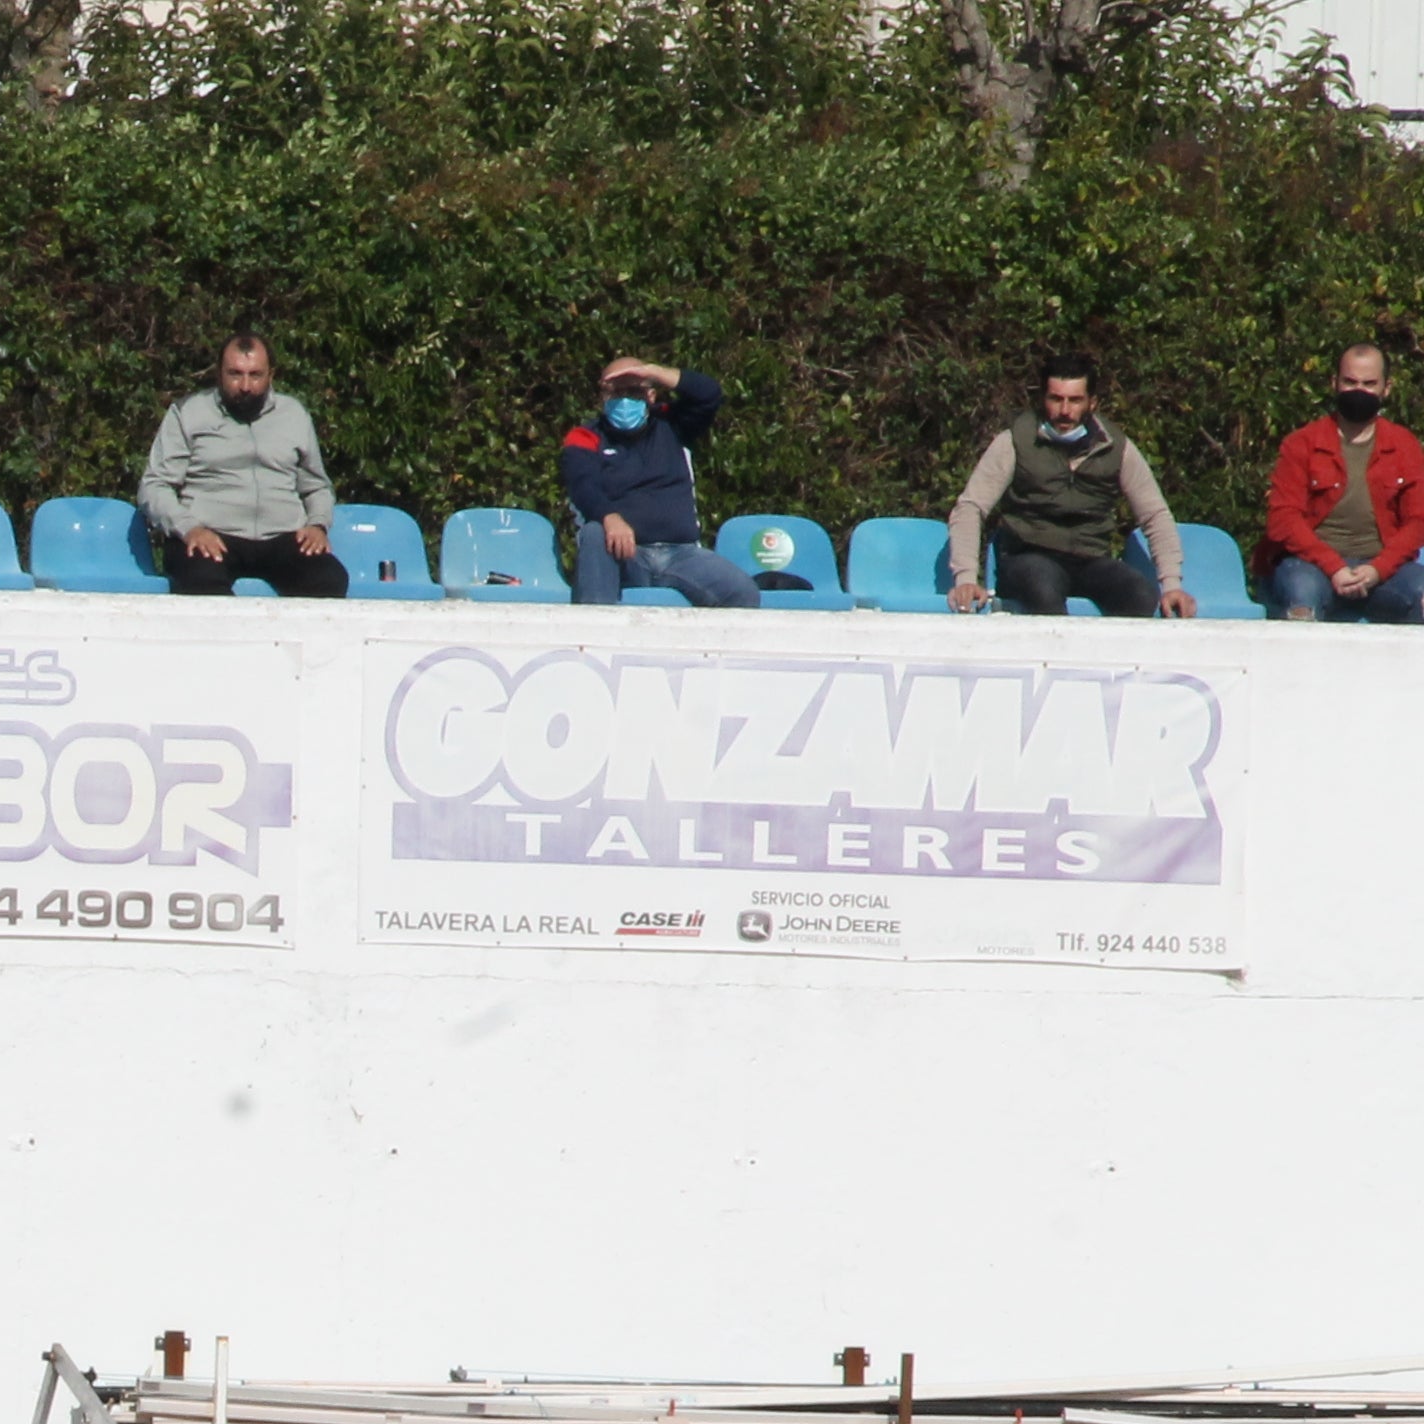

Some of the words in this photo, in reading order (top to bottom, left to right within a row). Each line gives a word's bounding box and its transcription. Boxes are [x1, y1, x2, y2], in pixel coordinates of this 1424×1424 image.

[390, 650, 1219, 820] GONZAMAR
[505, 811, 1104, 874] TALLERES
[36, 889, 153, 929] 490
[168, 892, 284, 933] 904
[751, 890, 824, 907] SERVICIO
[829, 893, 891, 909] OFICIAL
[375, 911, 496, 932] TALAVERA
[503, 915, 532, 934] LA
[539, 915, 600, 935] REAL
[620, 911, 683, 926] CASE
[779, 914, 832, 931] JOHN
[836, 916, 901, 934] DEERE
[779, 933, 827, 943] MOTORES
[1056, 932, 1088, 952] Tlf.
[1097, 933, 1134, 953] 924
[1142, 935, 1180, 953] 440
[1188, 936, 1226, 955] 538
